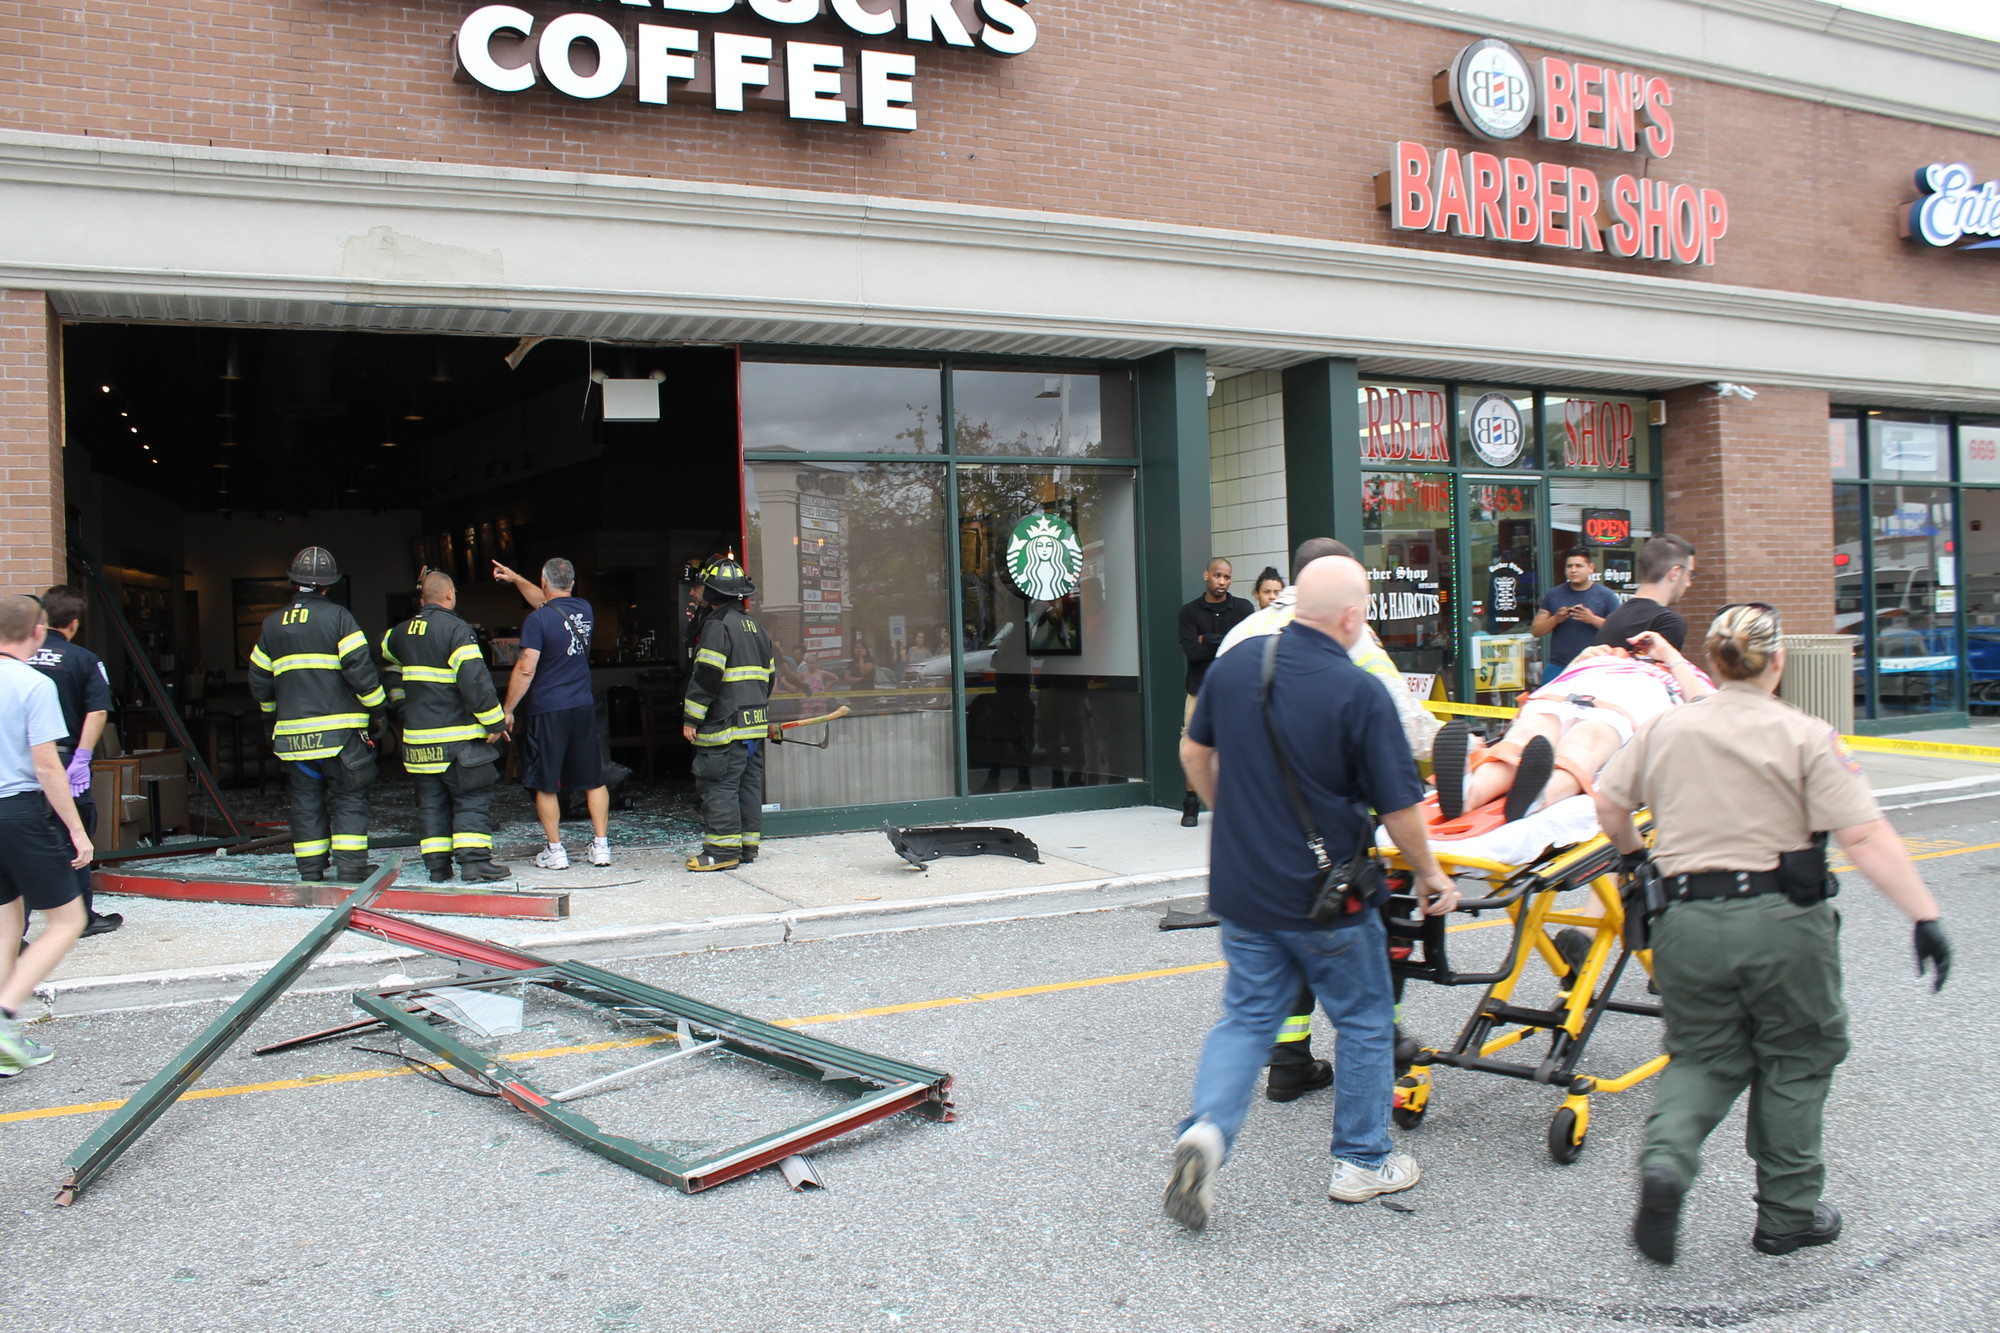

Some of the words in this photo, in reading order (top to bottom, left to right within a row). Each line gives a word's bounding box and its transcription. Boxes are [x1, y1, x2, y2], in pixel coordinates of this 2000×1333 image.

[456, 4, 918, 131] COFFEE
[1540, 56, 1674, 159] BEN'S
[1393, 140, 1603, 253] BARBER
[1606, 173, 1728, 267] SHOP
[1360, 386, 1450, 462] RBER
[1564, 397, 1634, 469] SHOP
[1586, 518, 1630, 538] OPEN
[1367, 567, 1392, 580] rber
[1395, 565, 1428, 582] Shop
[1604, 568, 1632, 583] Shop
[1379, 592, 1388, 620] &
[1388, 591, 1441, 621] HAIRCUTS
[282, 608, 309, 626] LFD
[407, 619, 428, 636] LFD
[27, 653, 63, 662] LICE
[287, 732, 324, 751] TKACZ
